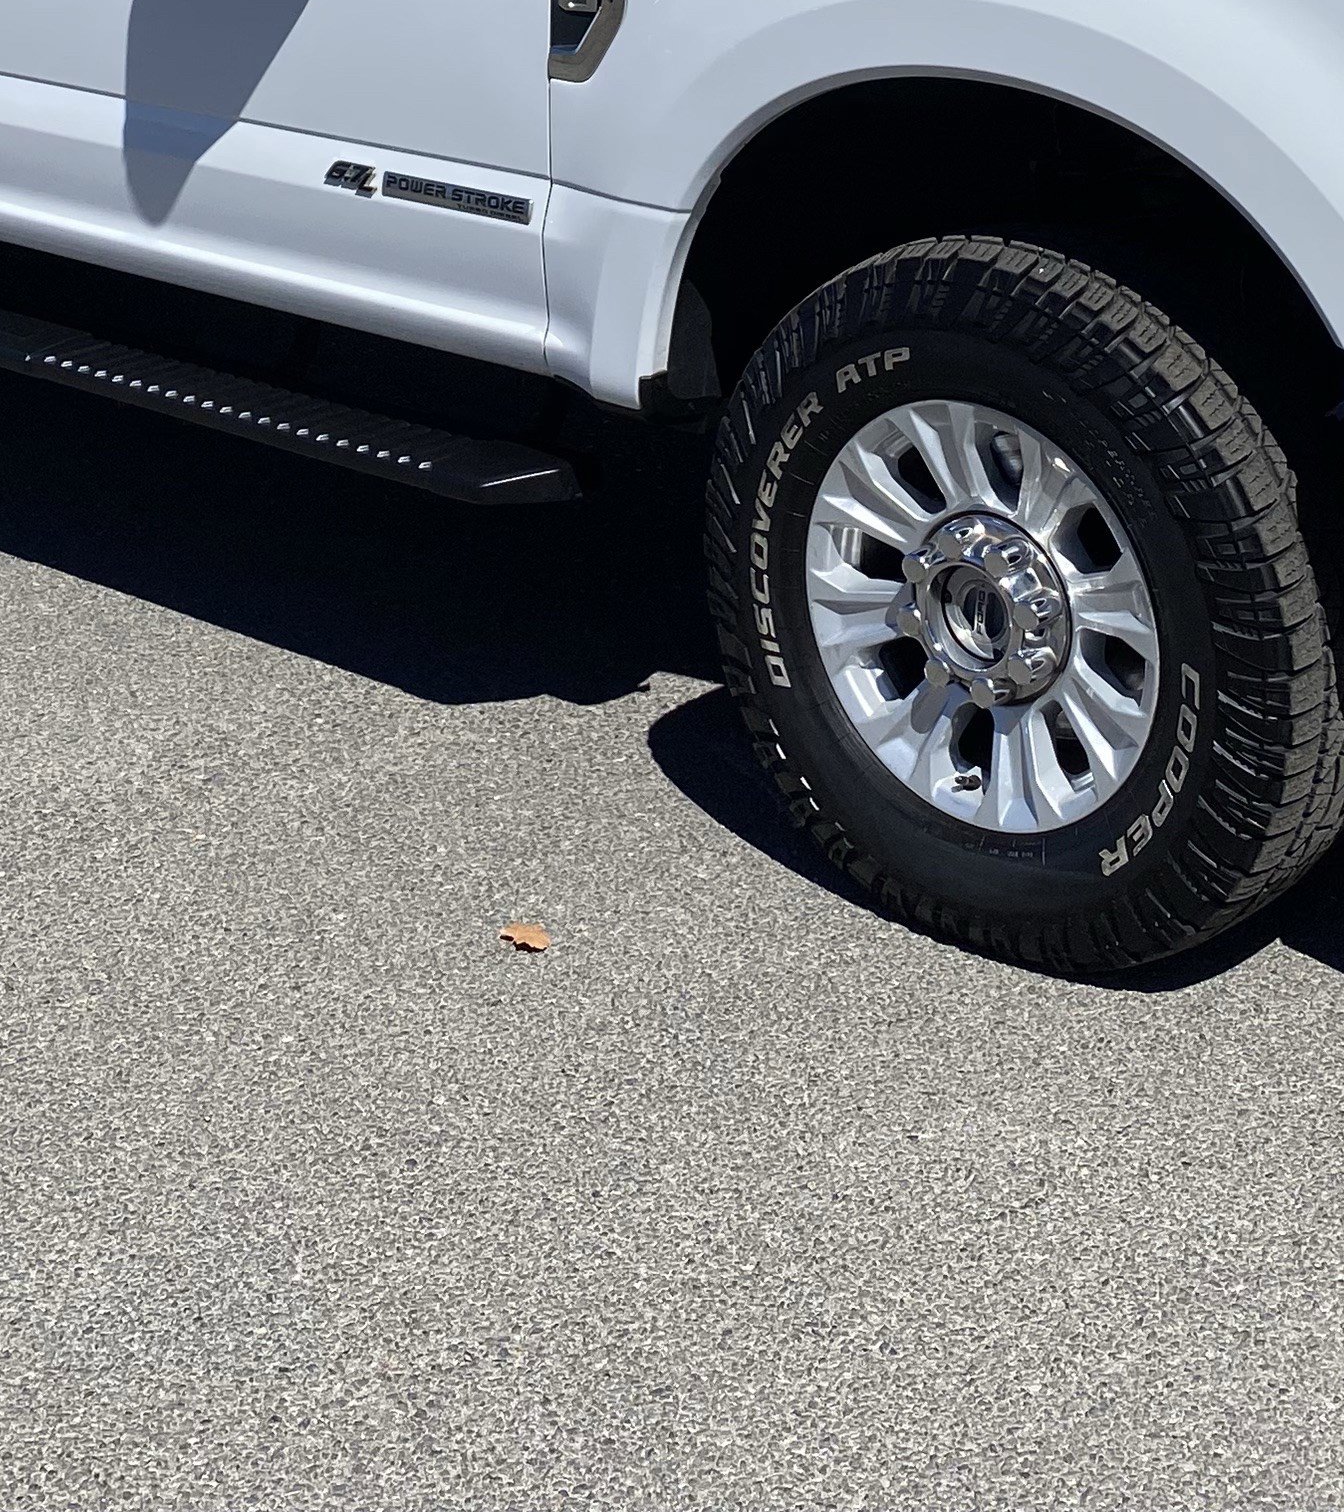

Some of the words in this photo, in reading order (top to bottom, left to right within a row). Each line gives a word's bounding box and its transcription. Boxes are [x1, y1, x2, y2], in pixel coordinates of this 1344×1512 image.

[385, 174, 446, 199] POWER
[451, 189, 525, 215] STROKE
[750, 391, 824, 688] DISCOVERER
[836, 347, 911, 393] ATP
[1098, 662, 1200, 877] COOPER
